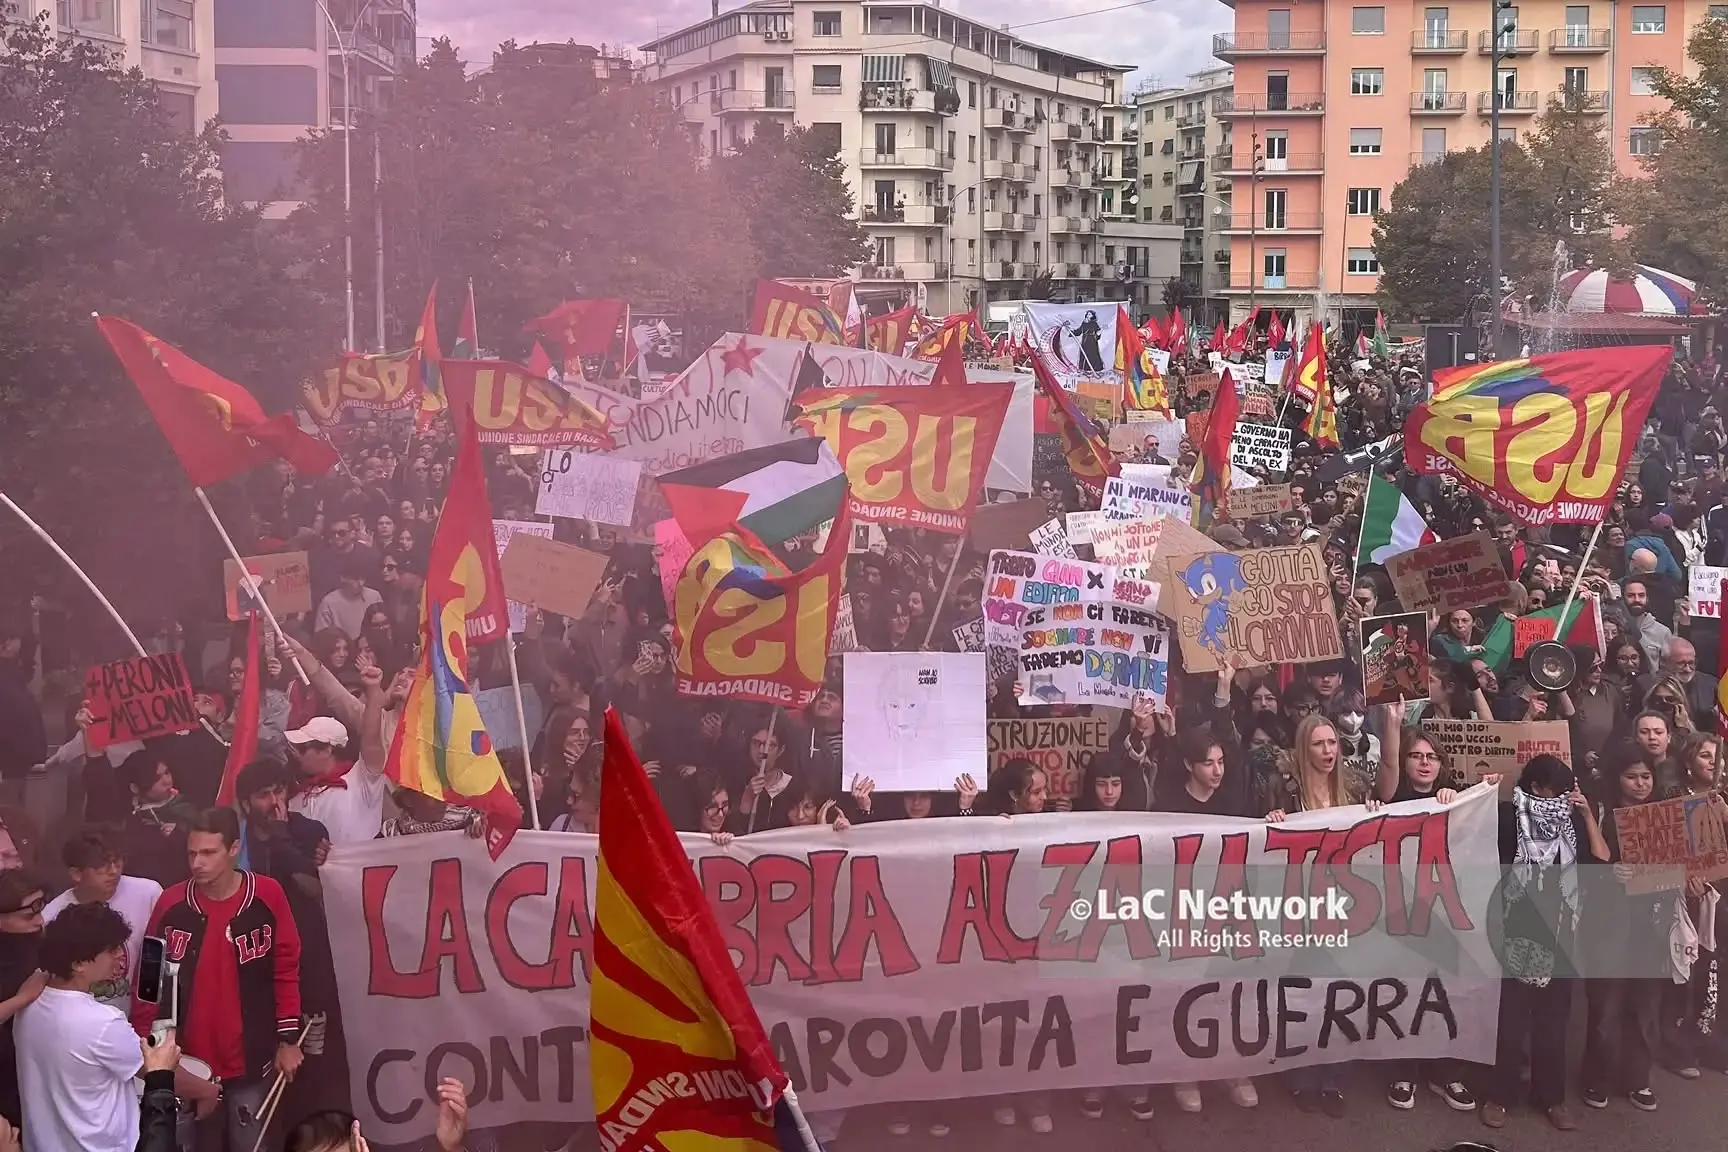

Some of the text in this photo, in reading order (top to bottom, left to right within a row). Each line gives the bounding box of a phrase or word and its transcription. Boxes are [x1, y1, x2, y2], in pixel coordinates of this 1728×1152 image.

[478, 432, 515, 444] UNIONE
[1241, 424, 1277, 438] GOVERNO
[1279, 429, 1290, 440] HA
[1237, 444, 1283, 459] DI ASCOLTO
[1232, 454, 1248, 465] DEL
[1269, 460, 1283, 469] EX
[1108, 480, 1123, 497] NI
[1090, 527, 1111, 544] NON
[1126, 536, 1140, 550] UN
[1241, 547, 1320, 585] GOTTA
[1087, 570, 1105, 589] X
[988, 577, 1016, 600] UN
[1242, 582, 1329, 616] GO STOP
[1025, 608, 1046, 627] SE
[1053, 604, 1084, 621] NON
[1698, 601, 1721, 616] FUT
[1021, 628, 1095, 650] SOGNARE
[1101, 628, 1134, 650] NON
[1227, 613, 1339, 662] IL CAROVITA
[1085, 650, 1168, 695] DORMIRE
[987, 720, 1093, 752] STRUZIONE
[1423, 723, 1489, 732] OH MIO DIO!
[1466, 734, 1501, 743] UCCISO
[1518, 740, 1560, 751] BRUTTI
[1443, 745, 1516, 755] OSTRO DIRITTO
[362, 810, 1475, 998] LA CABRIA ALZA LA TESTA
[365, 974, 1459, 1125] CONT AROVITA E GUERRA
